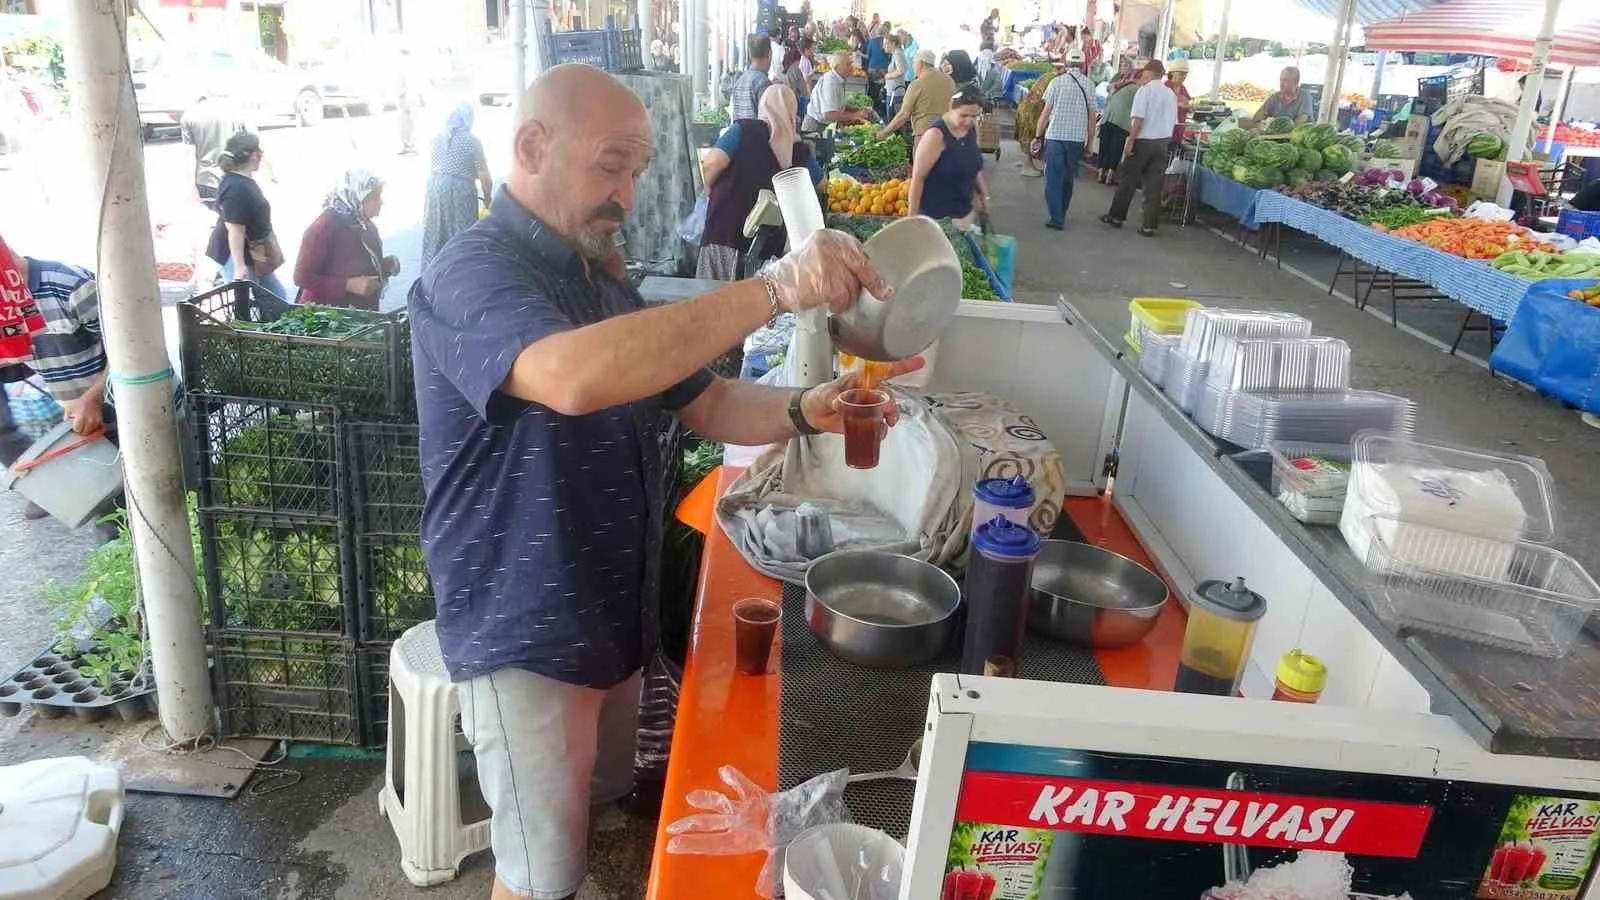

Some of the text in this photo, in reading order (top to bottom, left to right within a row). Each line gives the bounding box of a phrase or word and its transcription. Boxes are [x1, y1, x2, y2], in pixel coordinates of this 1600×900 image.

[1028, 785, 1355, 844] KAR HELVASI
[1538, 803, 1579, 817] KAR
[1525, 815, 1600, 830] HELVASI
[981, 830, 1019, 843] KAR
[970, 842, 1042, 856] HELVASI
